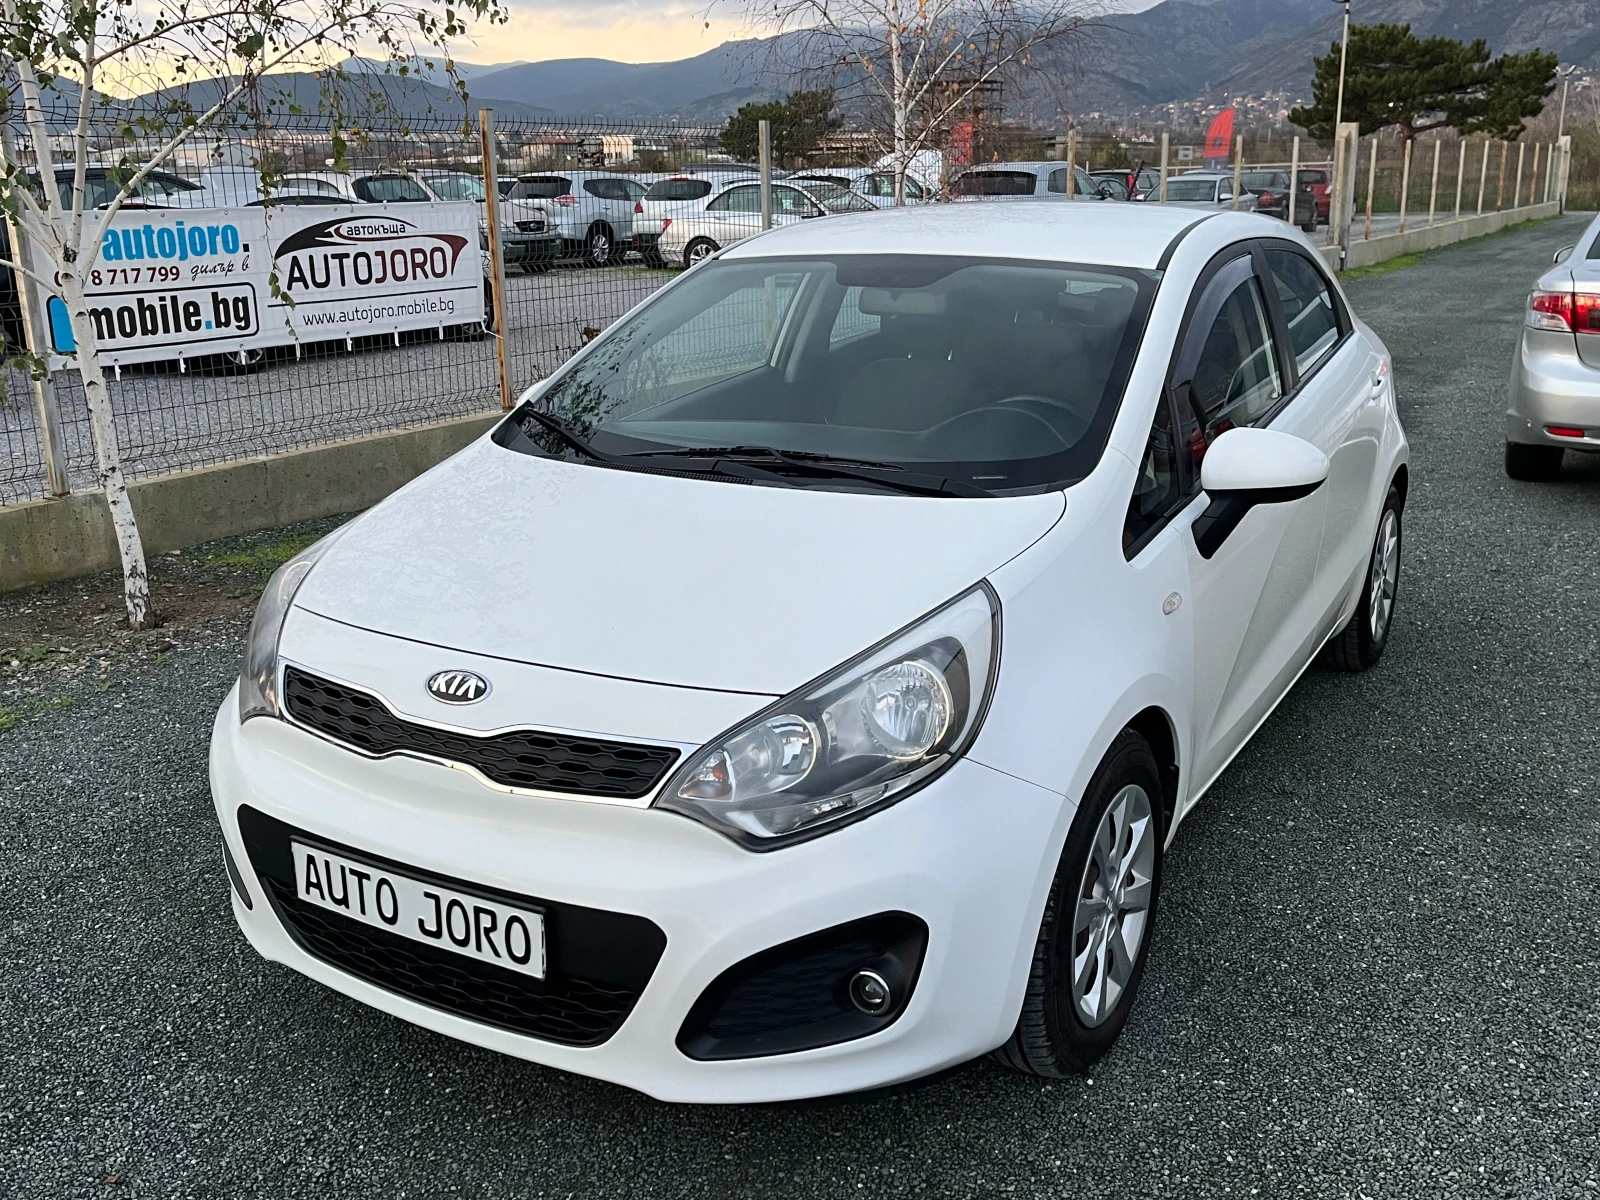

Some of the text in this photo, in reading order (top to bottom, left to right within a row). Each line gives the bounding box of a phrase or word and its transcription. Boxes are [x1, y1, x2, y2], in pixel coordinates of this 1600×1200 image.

[346, 223, 406, 236] автокъща
[107, 268, 142, 285] 717
[146, 265, 181, 283] 799
[287, 246, 448, 291] AUTOJORO
[88, 291, 251, 340] mobile.bg
[302, 296, 455, 325] www.autojoro.mobile.bg
[431, 673, 478, 699] KIA
[305, 852, 532, 966] AUTO JORO
